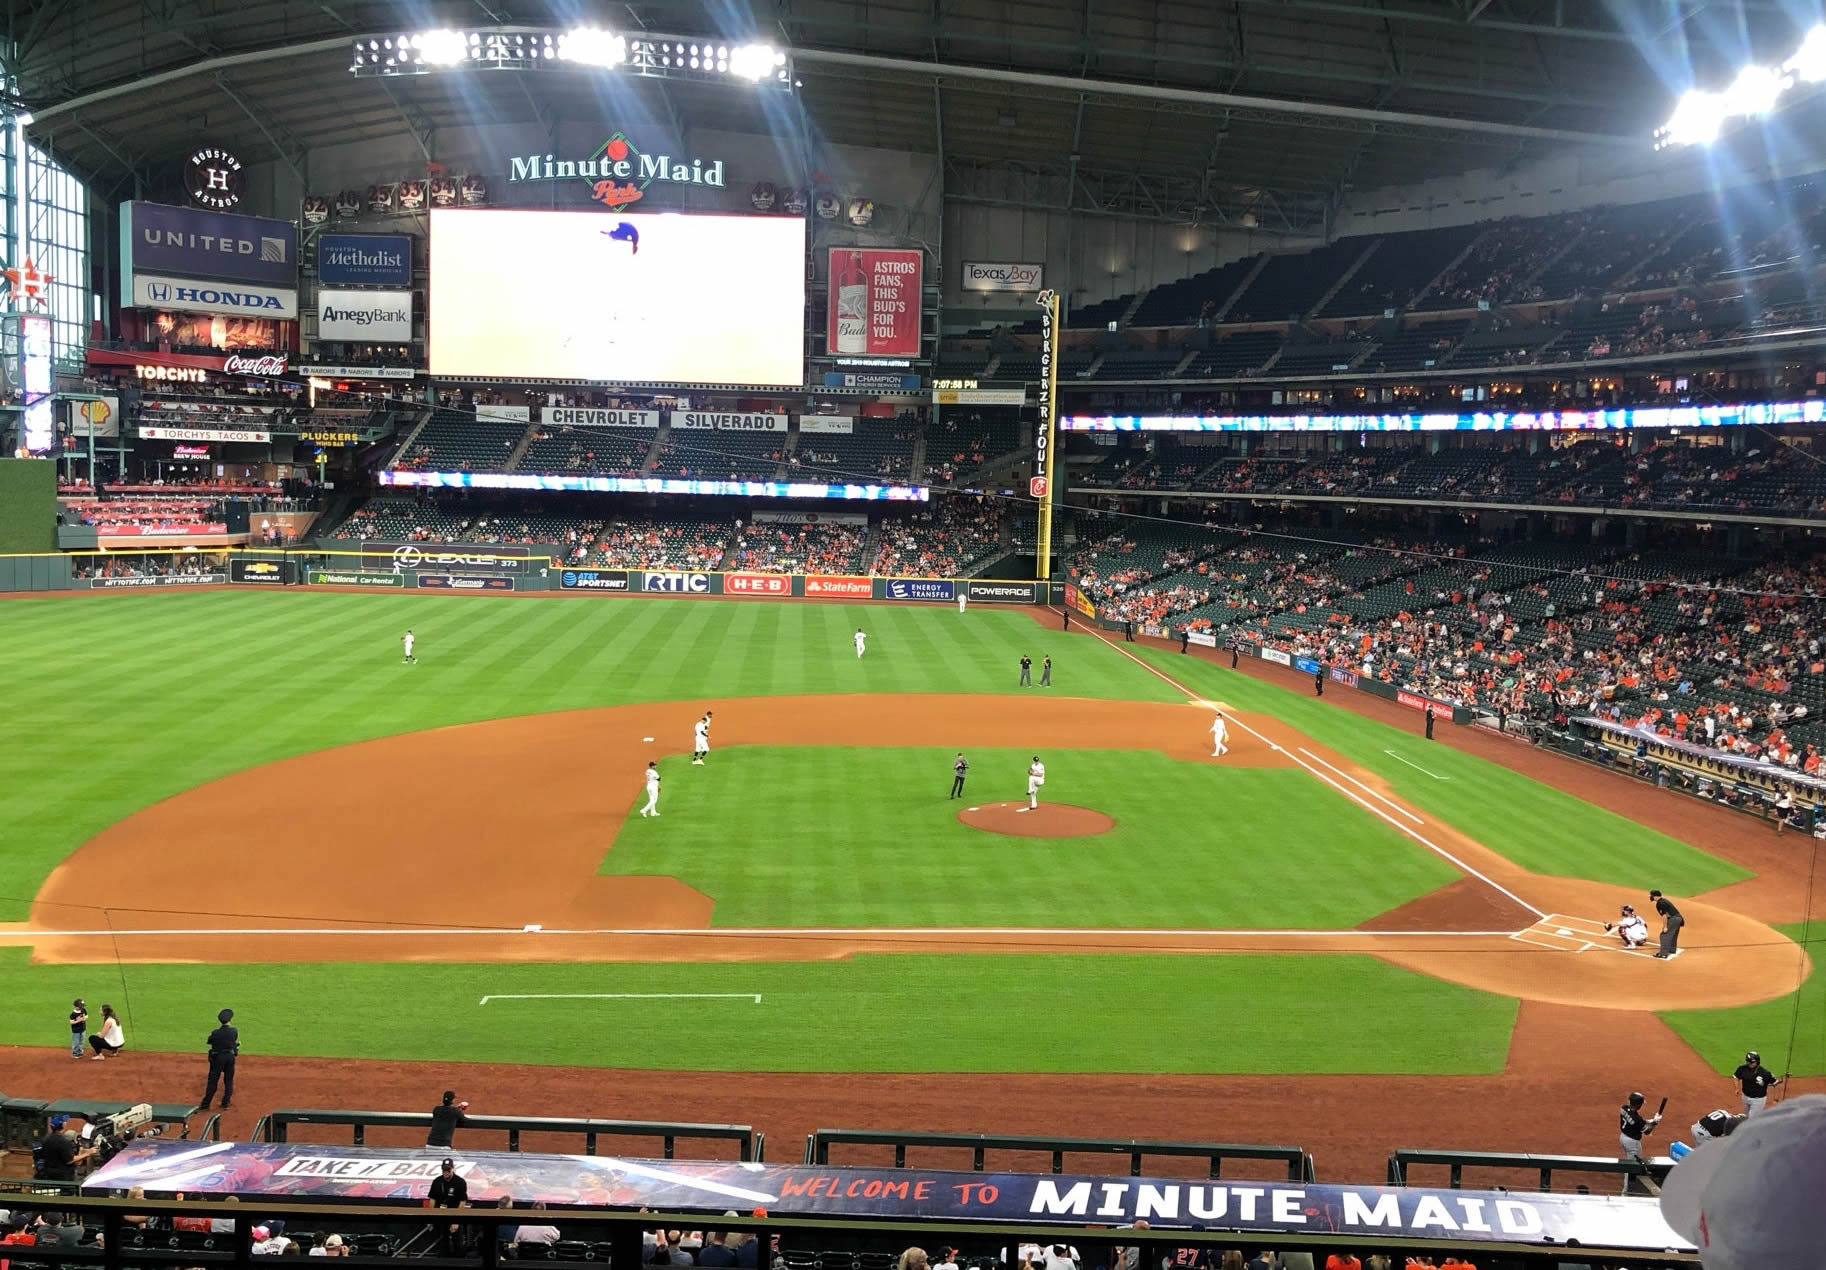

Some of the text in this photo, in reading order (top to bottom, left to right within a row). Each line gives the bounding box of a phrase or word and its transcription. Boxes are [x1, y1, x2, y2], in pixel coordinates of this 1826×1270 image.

[192, 149, 241, 171] HOUSTON
[509, 153, 725, 187] Minute Maid
[207, 168, 229, 190] H
[194, 190, 239, 208] ASTROS
[593, 180, 643, 206] Park
[145, 228, 254, 254] UNITED
[326, 250, 402, 266] Methodist
[874, 262, 915, 274] ASTROS
[968, 265, 1038, 285] Texas Bay
[874, 274, 904, 288] FANS,
[176, 287, 285, 310] HONDA
[874, 287, 898, 300] THIS
[873, 300, 906, 313] BUD'S
[322, 306, 407, 326] AmegyBank
[873, 313, 894, 326] FOR
[873, 326, 897, 338] YOU.
[136, 365, 207, 382] TORCHYS
[857, 375, 901, 383] CHAMPION
[964, 380, 978, 389] PM
[552, 408, 648, 426] CHEVROLET
[685, 413, 775, 430] SILVERADO
[164, 430, 249, 440] TORCHYS TACOS
[301, 432, 358, 441] PLUCKERS
[1038, 424, 1047, 474] FOUL
[140, 525, 189, 535] Budweiser
[500, 559, 518, 567] 373
[327, 574, 394, 585] National Car Rental
[577, 579, 626, 588] SPORTSNET
[645, 573, 707, 591] RTIC
[912, 584, 942, 592] ENERGY
[912, 591, 949, 599] TRANSFER
[971, 587, 1031, 596] POWERADE
[289, 1159, 362, 1175] TAKE
[780, 1175, 1543, 1235] WELCOME TO MINUTE MAID
[1177, 1248, 1198, 1267] 27
